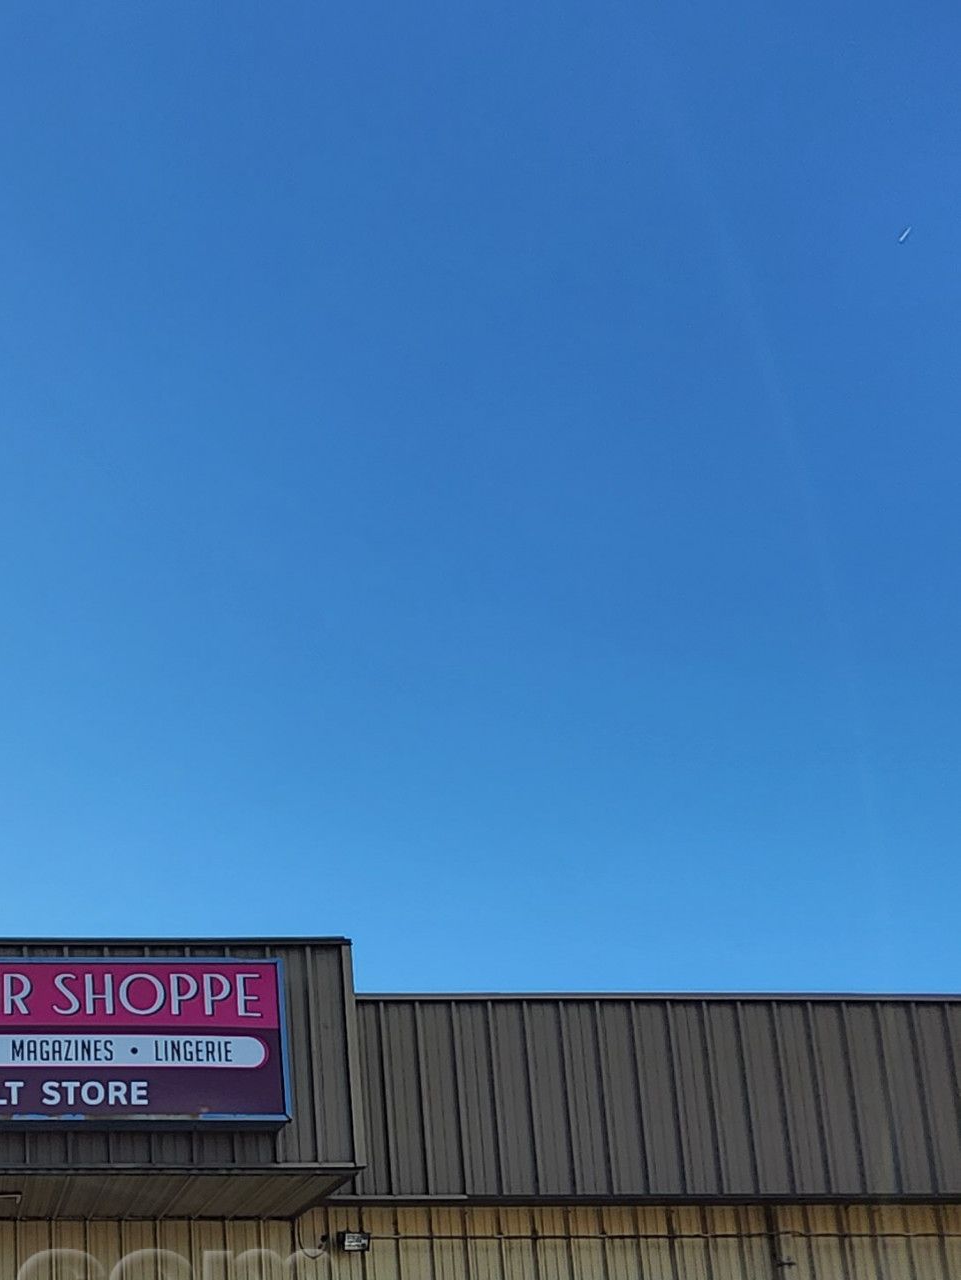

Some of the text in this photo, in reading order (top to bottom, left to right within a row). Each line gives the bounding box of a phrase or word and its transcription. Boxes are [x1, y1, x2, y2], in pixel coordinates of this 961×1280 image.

[52, 972, 263, 1018] SHOPPE
[11, 1039, 114, 1062] MAGAZINES
[154, 1040, 233, 1062] LINGERIE
[41, 1081, 149, 1106] STORE
